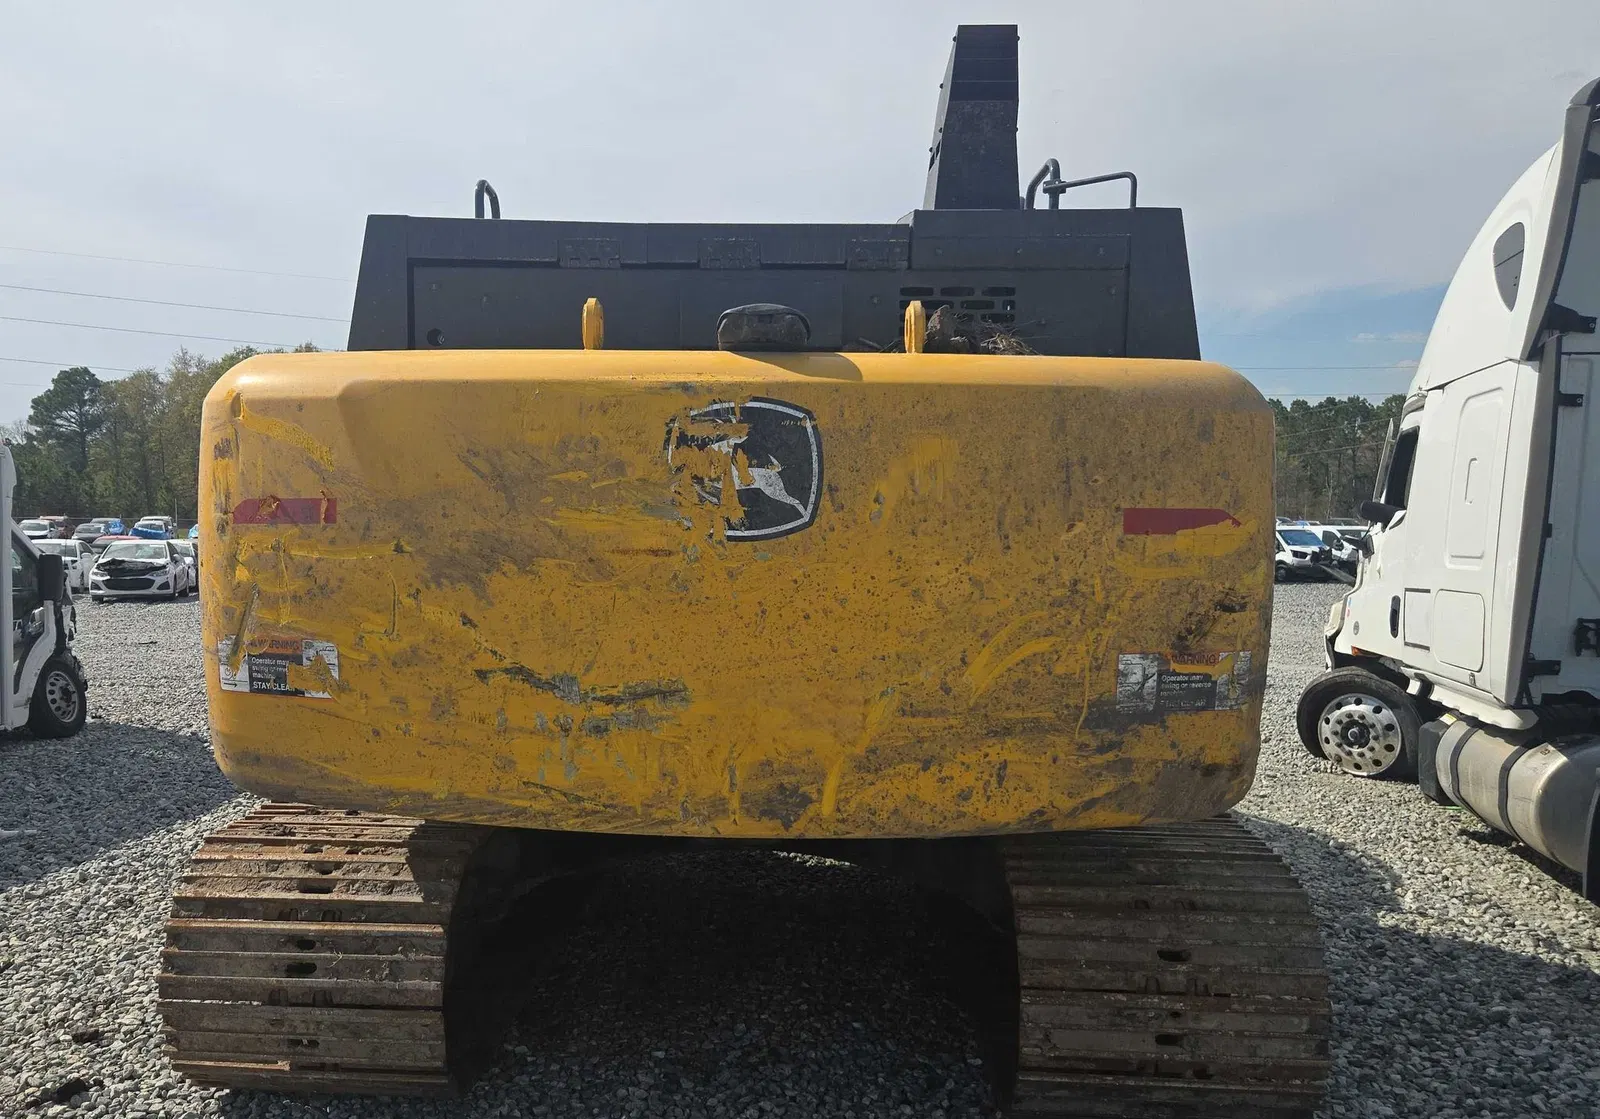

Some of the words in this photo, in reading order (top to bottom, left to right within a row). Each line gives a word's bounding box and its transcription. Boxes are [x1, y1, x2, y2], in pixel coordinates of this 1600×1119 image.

[251, 657, 276, 665] Operator
[1161, 674, 1189, 683] Operator
[253, 681, 271, 689] STAY
